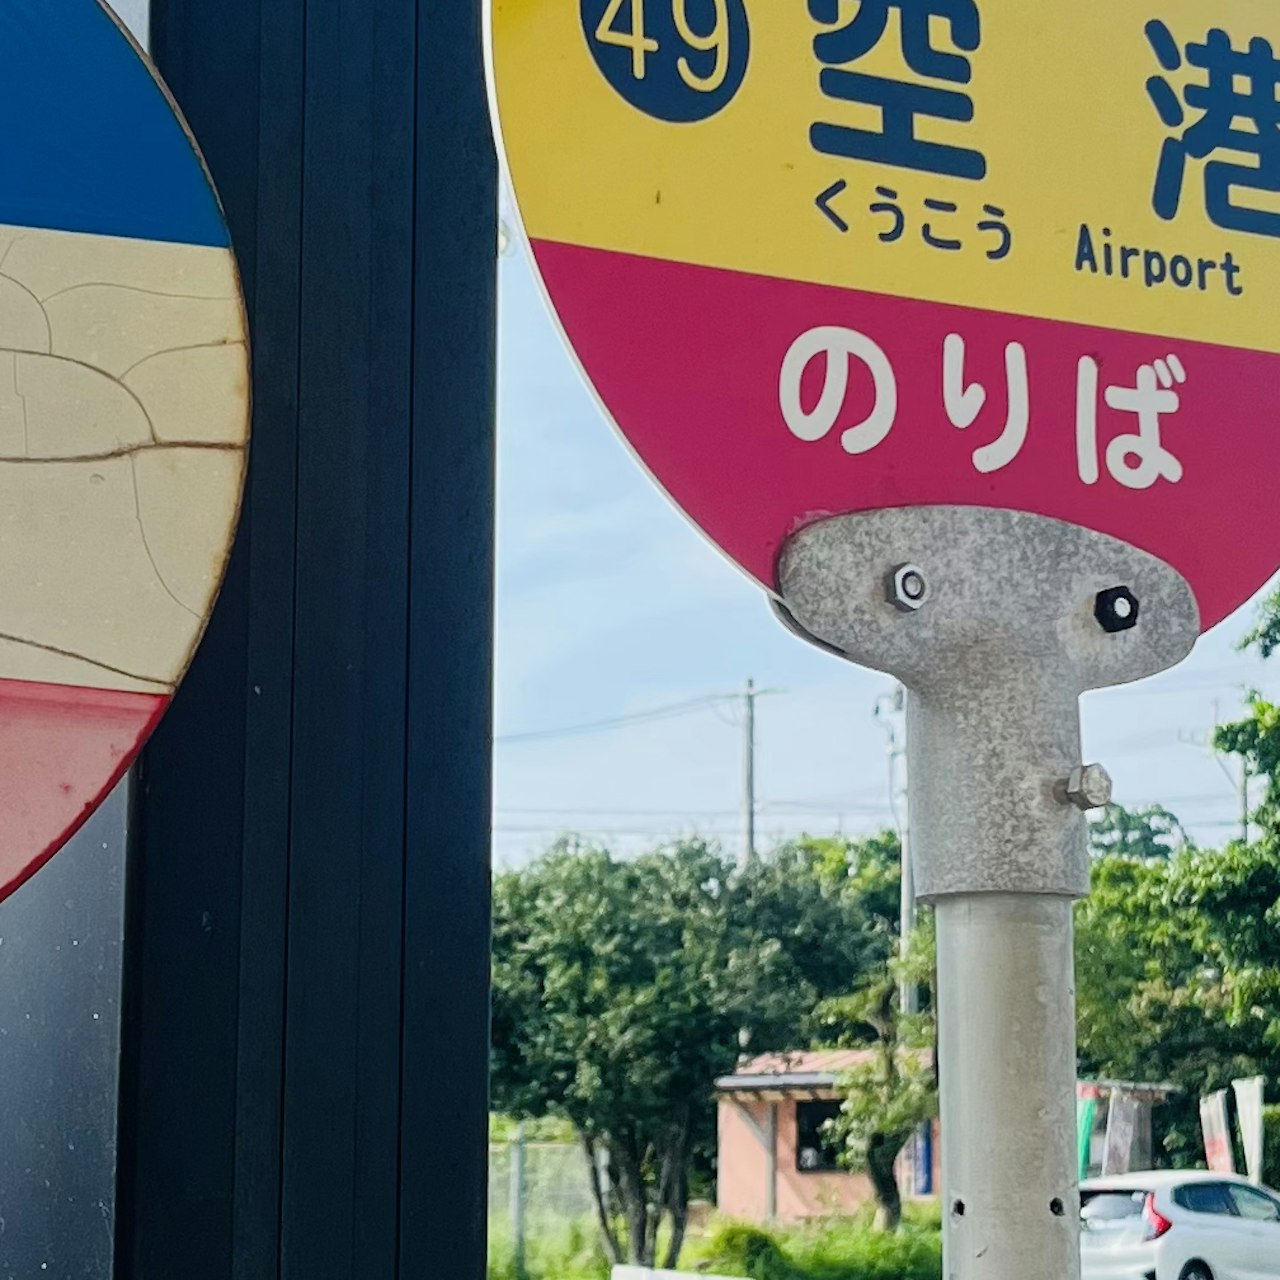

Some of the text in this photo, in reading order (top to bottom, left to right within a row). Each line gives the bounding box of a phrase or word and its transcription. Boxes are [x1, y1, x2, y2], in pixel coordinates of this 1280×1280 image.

[814, 178, 1243, 297] くうこう Airport
[778, 324, 1186, 491] のりば
